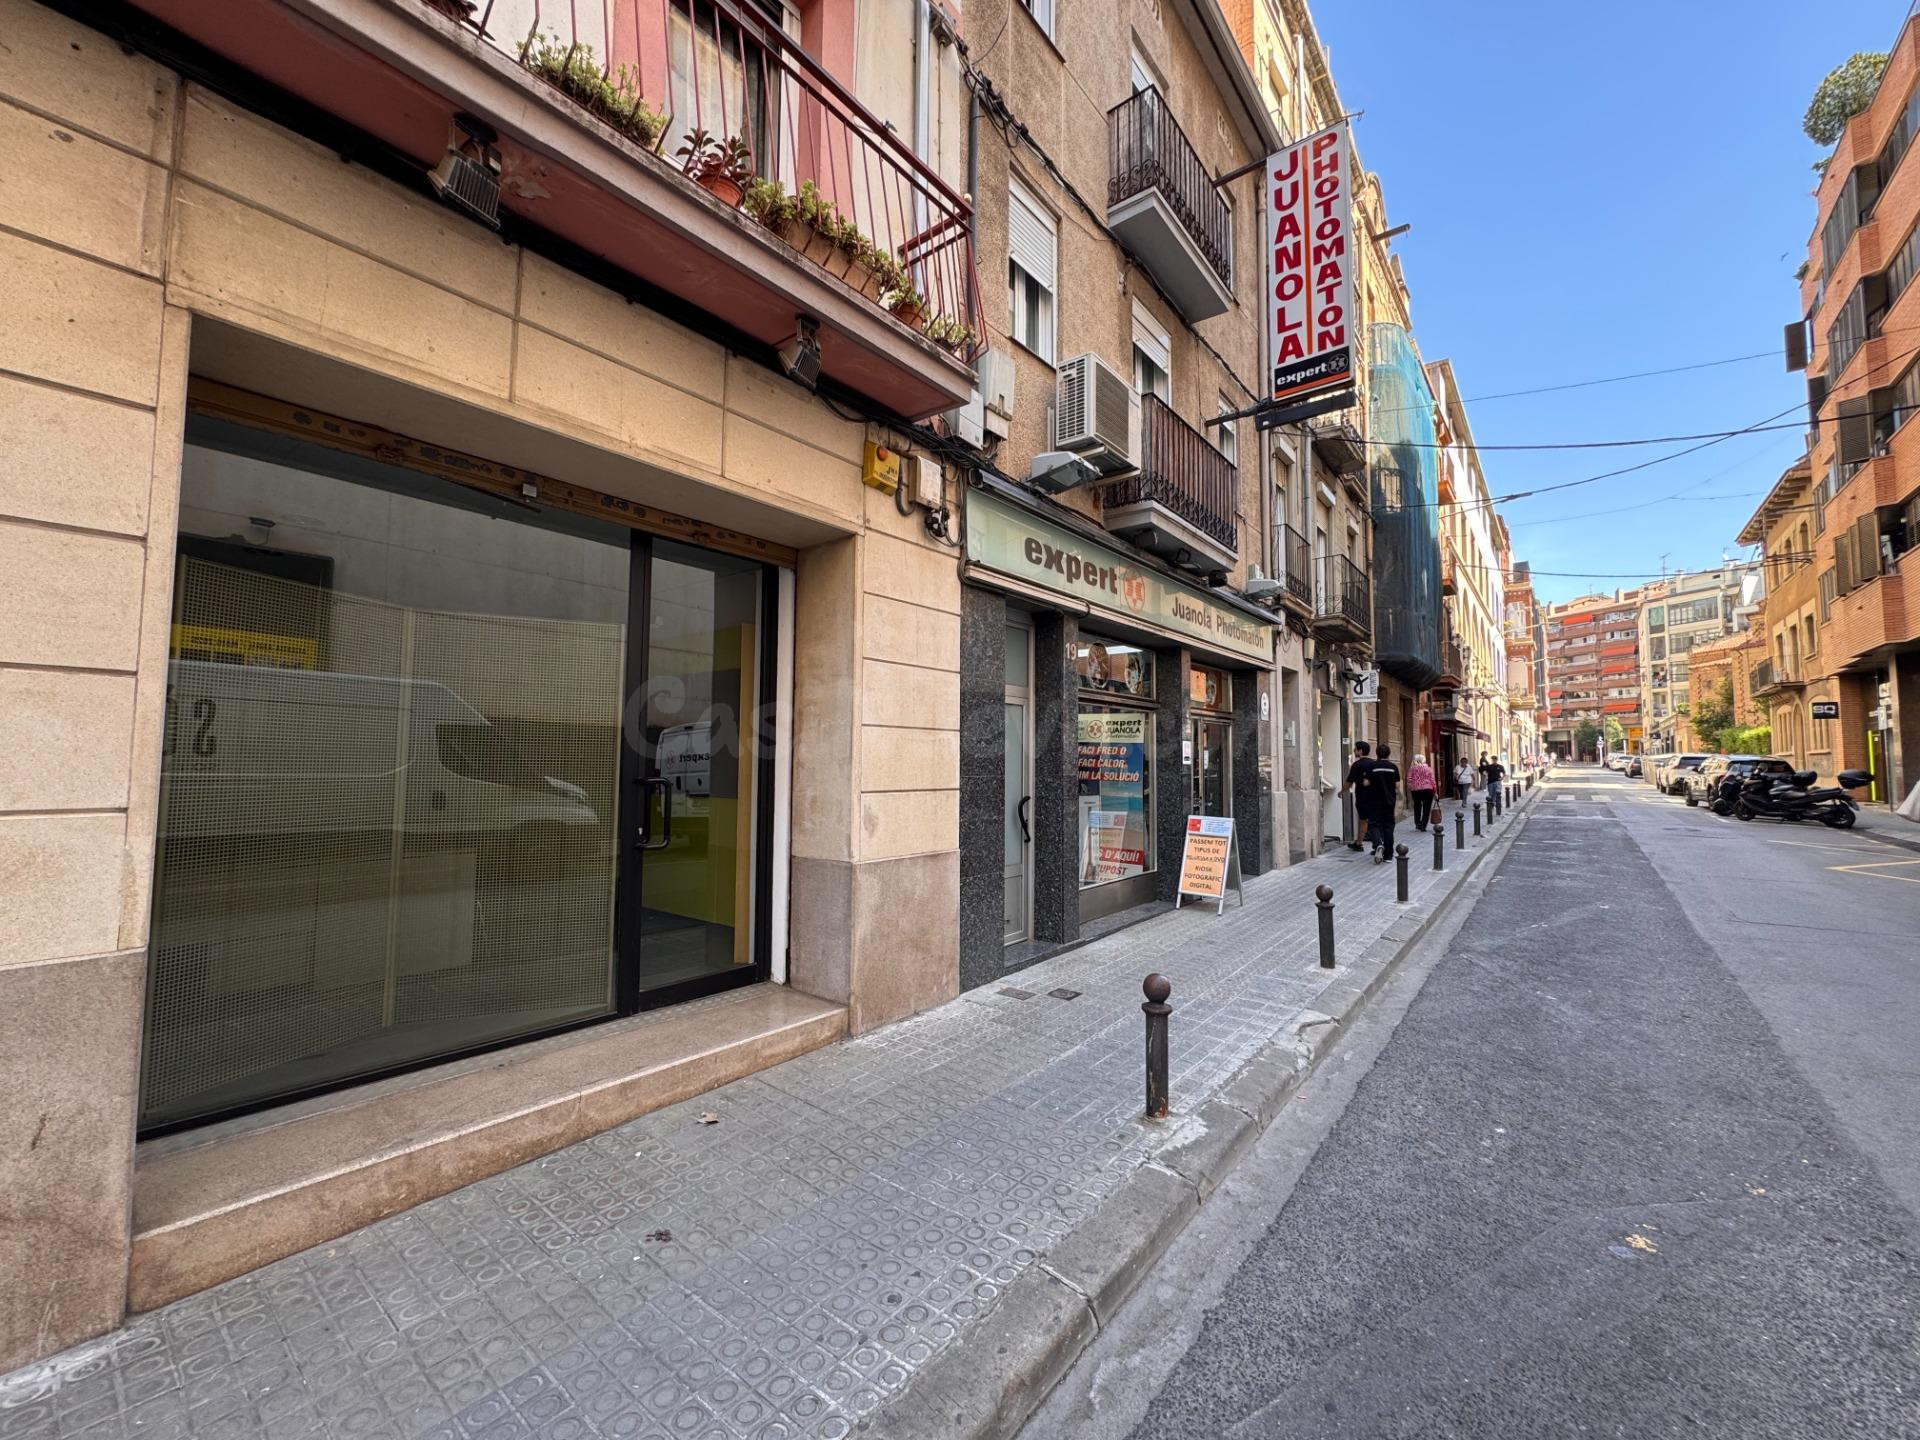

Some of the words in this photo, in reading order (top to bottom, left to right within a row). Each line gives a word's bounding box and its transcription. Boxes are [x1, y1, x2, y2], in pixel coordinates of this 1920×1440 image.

[1312, 131, 1345, 351] PHOTOMATON
[1274, 148, 1304, 366] JUANOLA
[1276, 362, 1328, 387] expert
[1024, 536, 1118, 594] expert
[1172, 597, 1212, 630] Juanola
[1065, 643, 1077, 660] 19
[1813, 705, 1836, 714] SQ
[1105, 719, 1142, 727] expert
[1097, 746, 1118, 755] FRED
[1091, 771, 1101, 780] LA
[1103, 771, 1140, 782] SOLUCIÓ
[1189, 838, 1214, 846] PASSEM
[1189, 882, 1212, 890] DIGITAL
